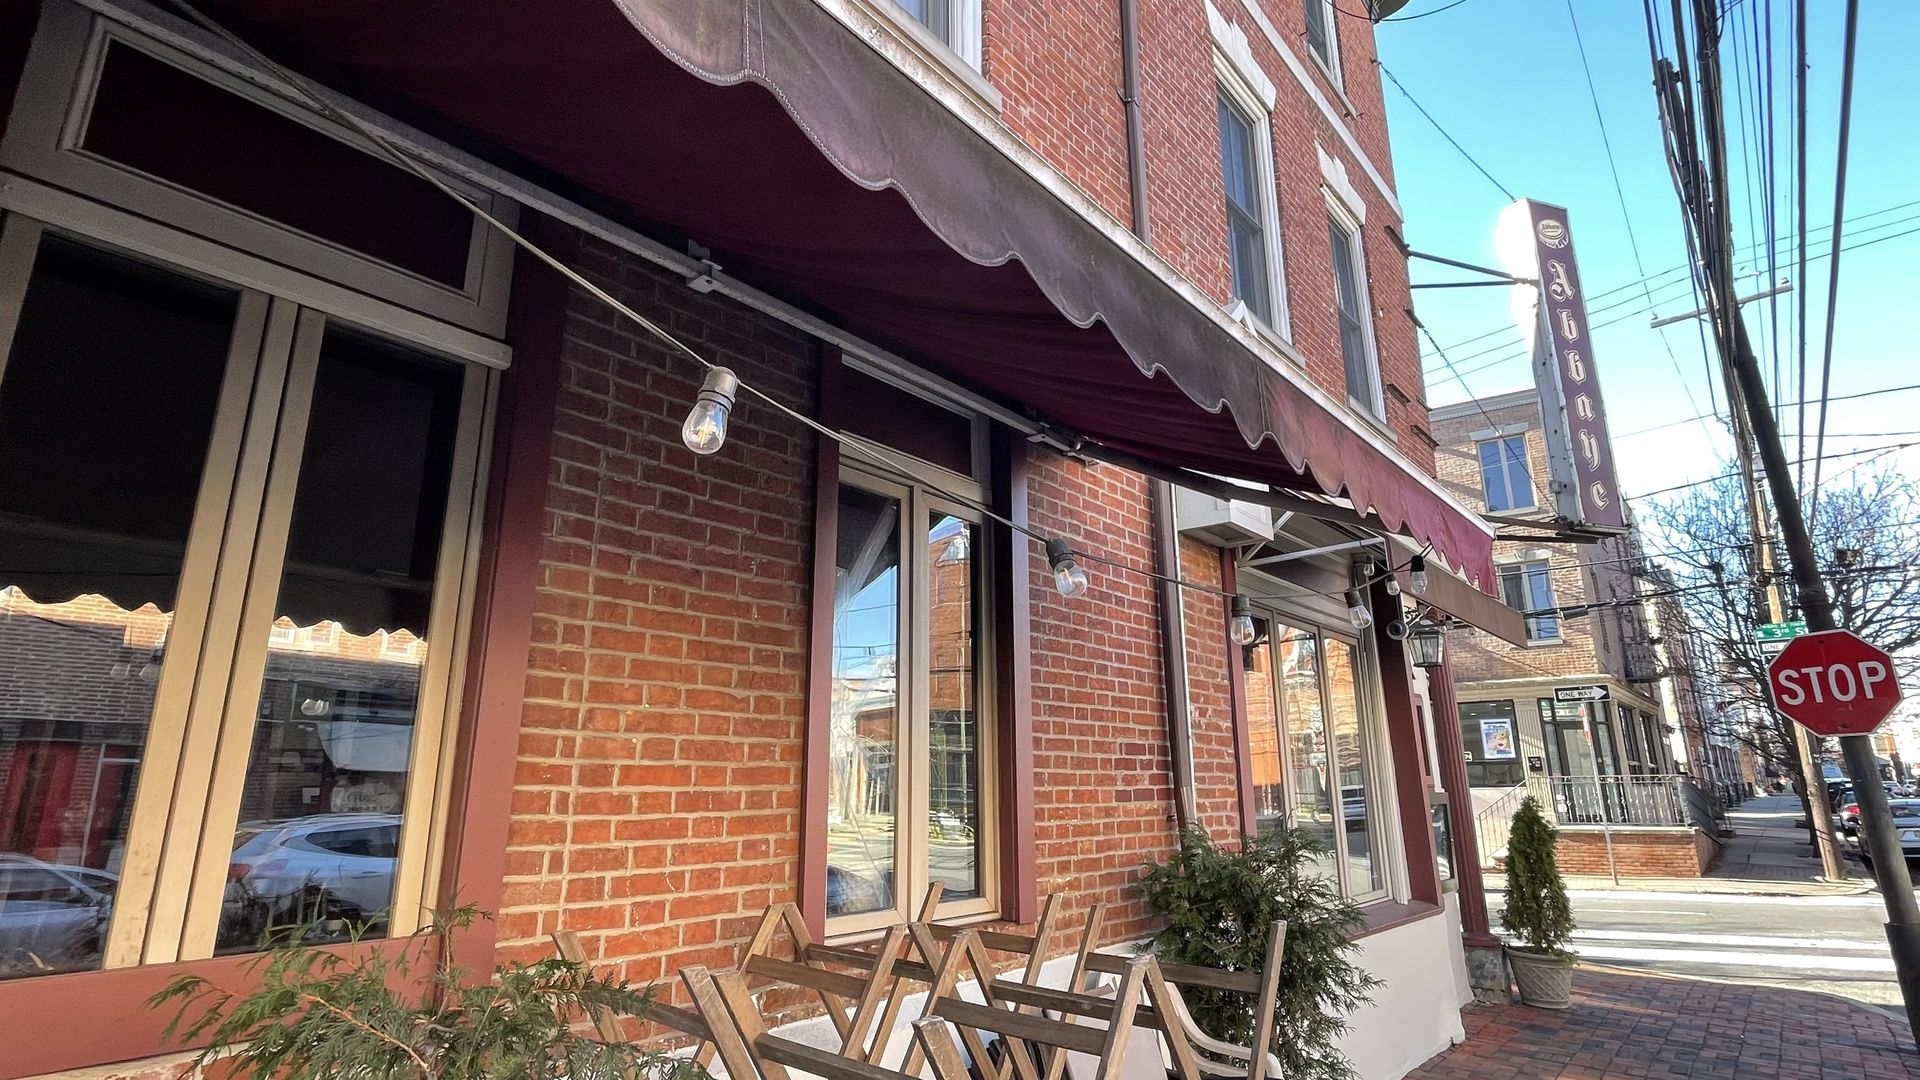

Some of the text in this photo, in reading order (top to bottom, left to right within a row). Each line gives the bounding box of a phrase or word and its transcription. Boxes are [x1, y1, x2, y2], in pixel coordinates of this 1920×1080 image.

[1547, 259, 1609, 510] Abbaye
[1772, 627, 1790, 638] 3rd
[1764, 643, 1781, 651] ONE
[1777, 660, 1887, 706] STOP
[1560, 691, 1576, 699] ONE
